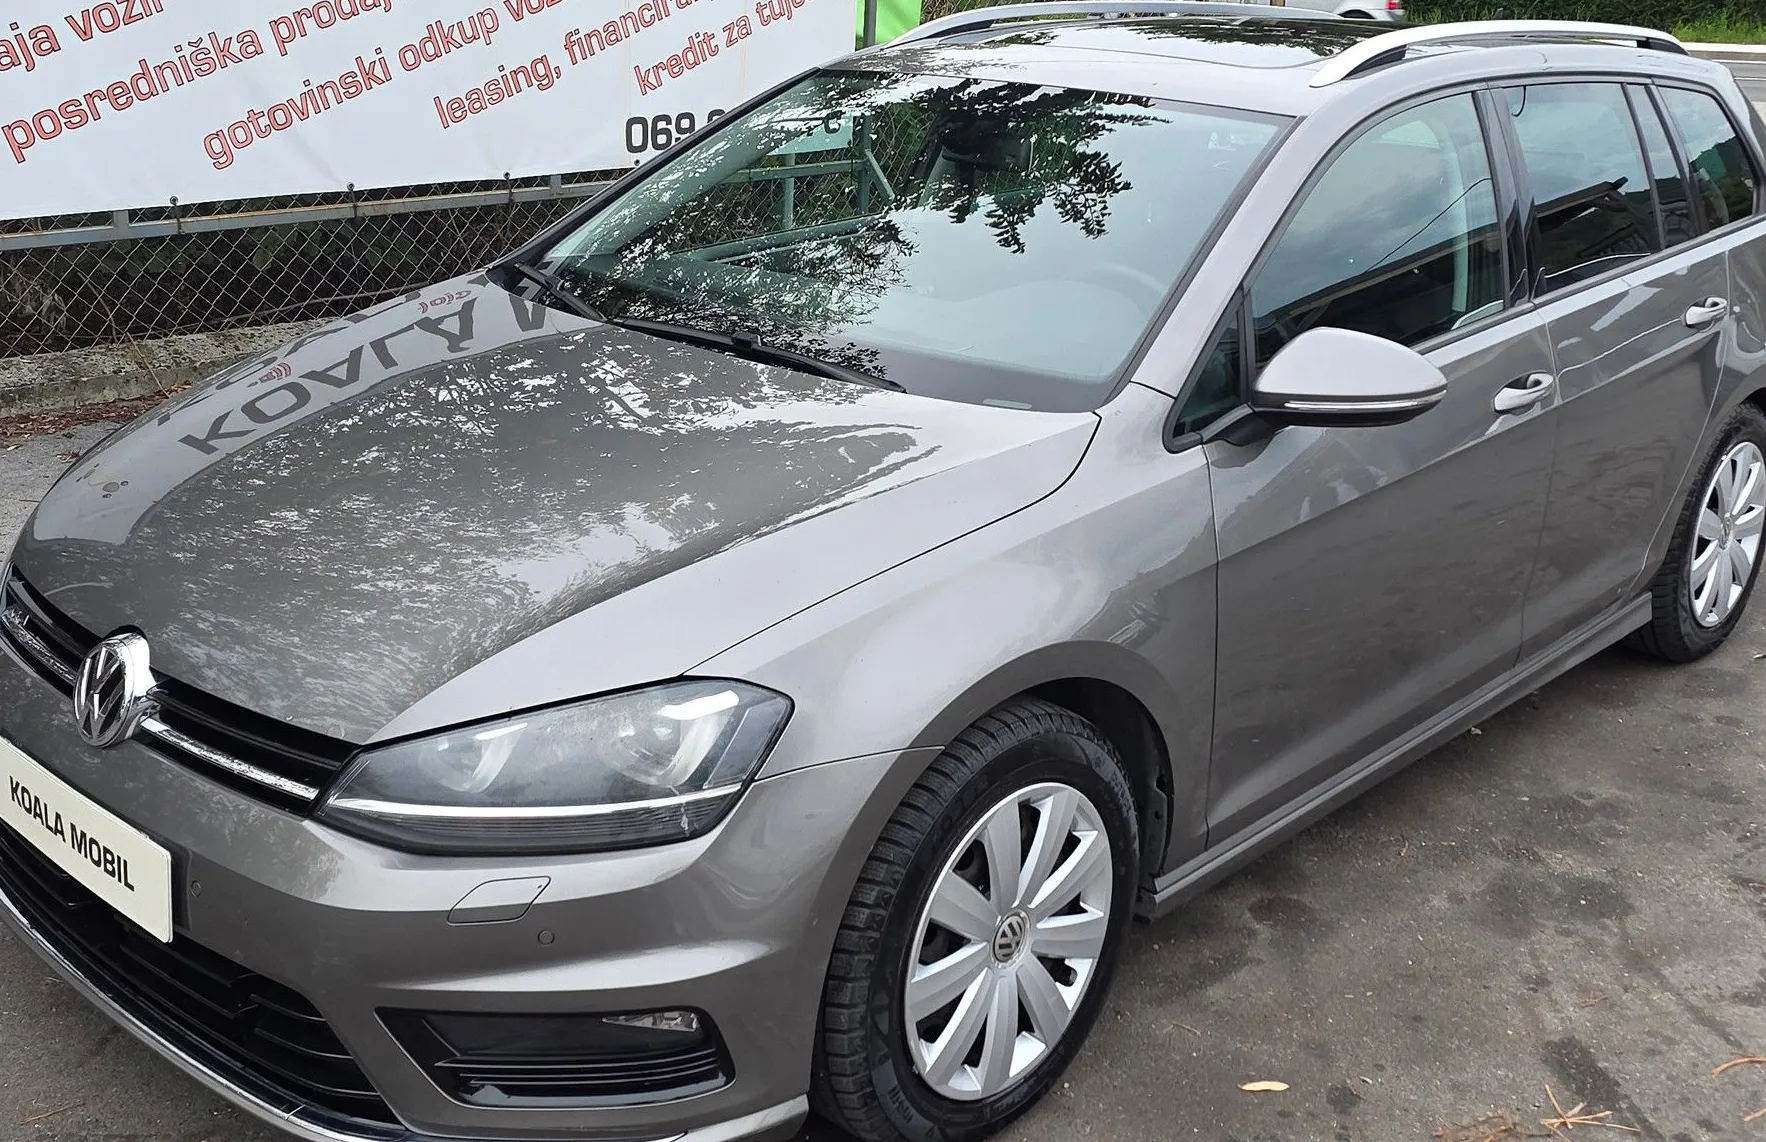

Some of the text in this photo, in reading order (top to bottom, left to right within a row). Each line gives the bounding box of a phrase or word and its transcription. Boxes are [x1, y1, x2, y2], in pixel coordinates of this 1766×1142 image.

[1, 31, 263, 164] posredniška
[203, 47, 393, 170] gotovinski
[398, 7, 500, 72] odkup
[433, 54, 561, 129] leasing,
[634, 31, 720, 96] kredit
[722, 14, 753, 48] za
[8, 775, 135, 893] KOALA MOBIL
